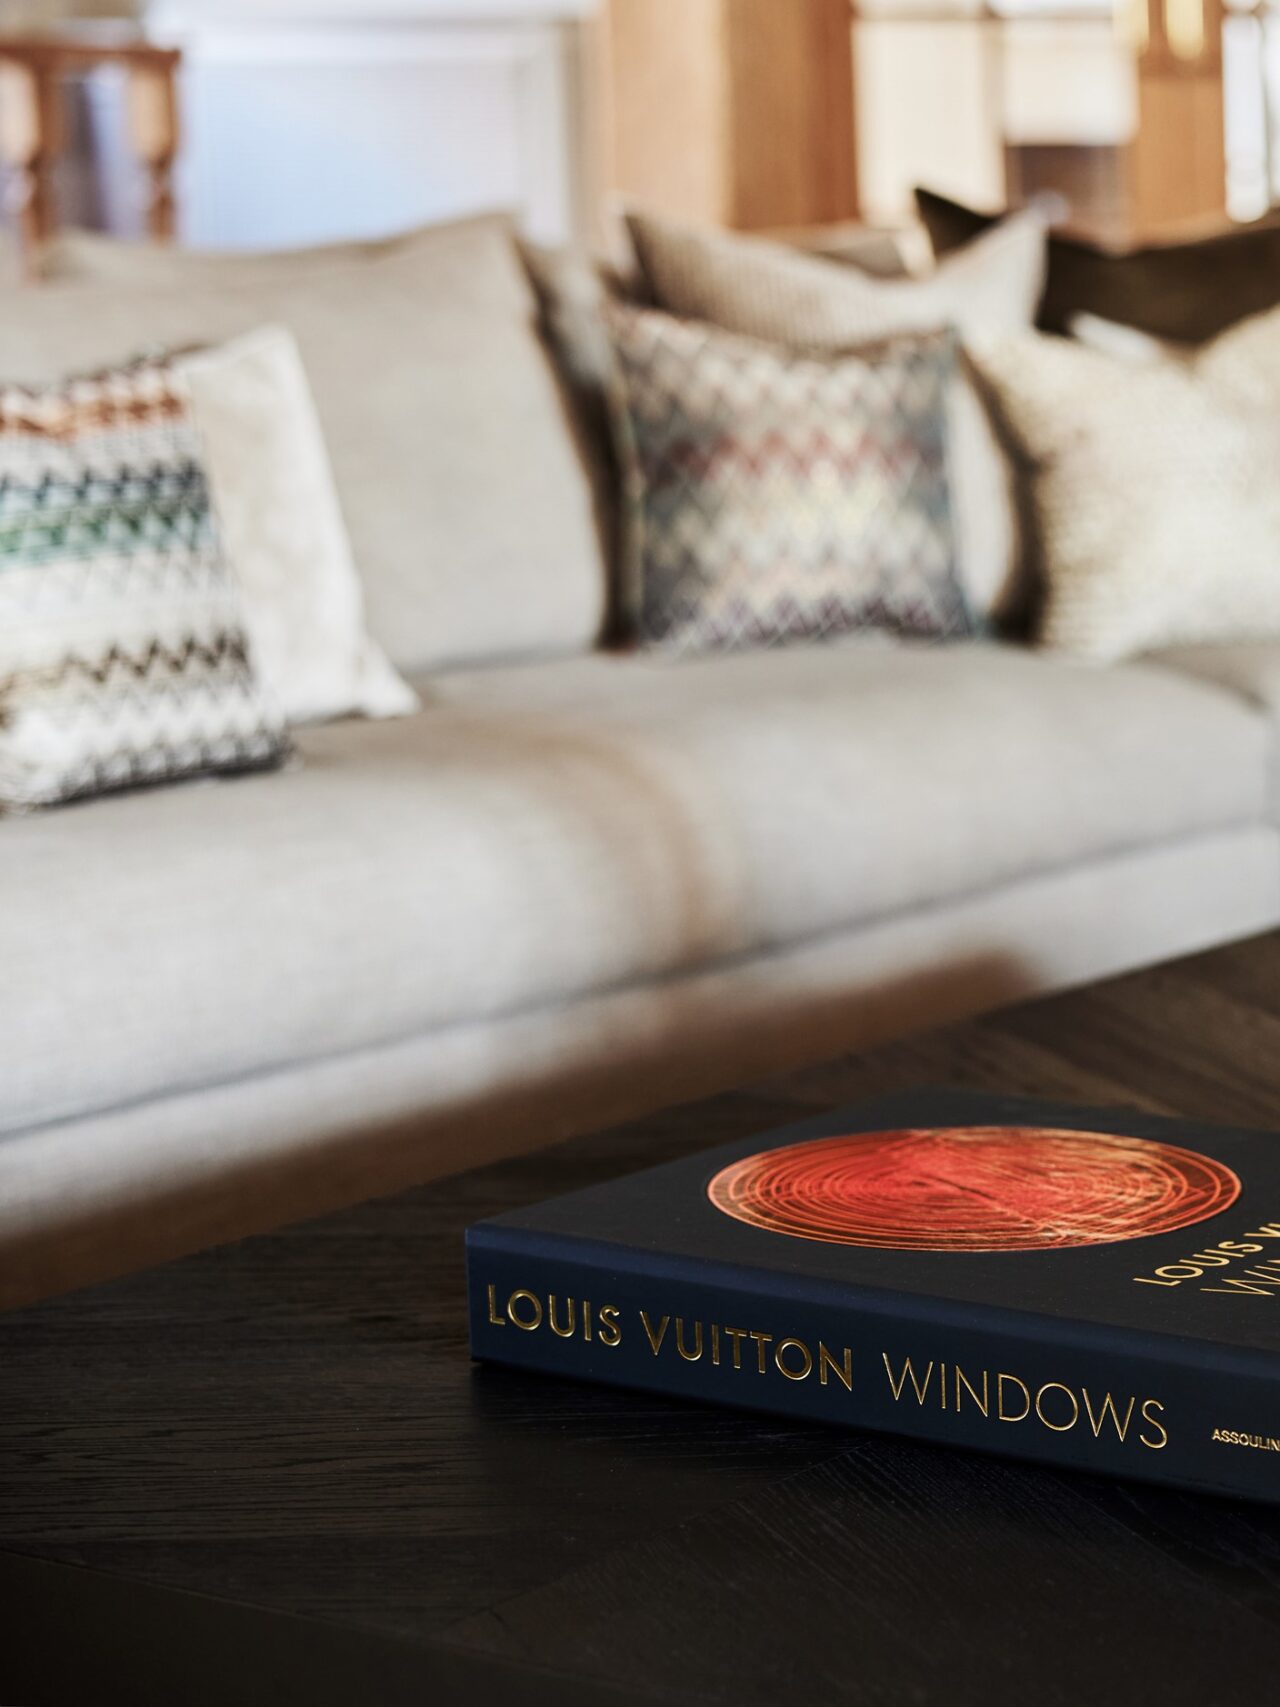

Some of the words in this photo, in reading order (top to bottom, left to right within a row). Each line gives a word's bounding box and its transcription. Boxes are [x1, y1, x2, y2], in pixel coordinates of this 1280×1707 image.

[1133, 1239, 1264, 1287] LOUIS
[488, 1285, 620, 1345] LOUIS
[641, 1311, 852, 1390] VUITTON
[883, 1354, 1168, 1450] WINDOWS
